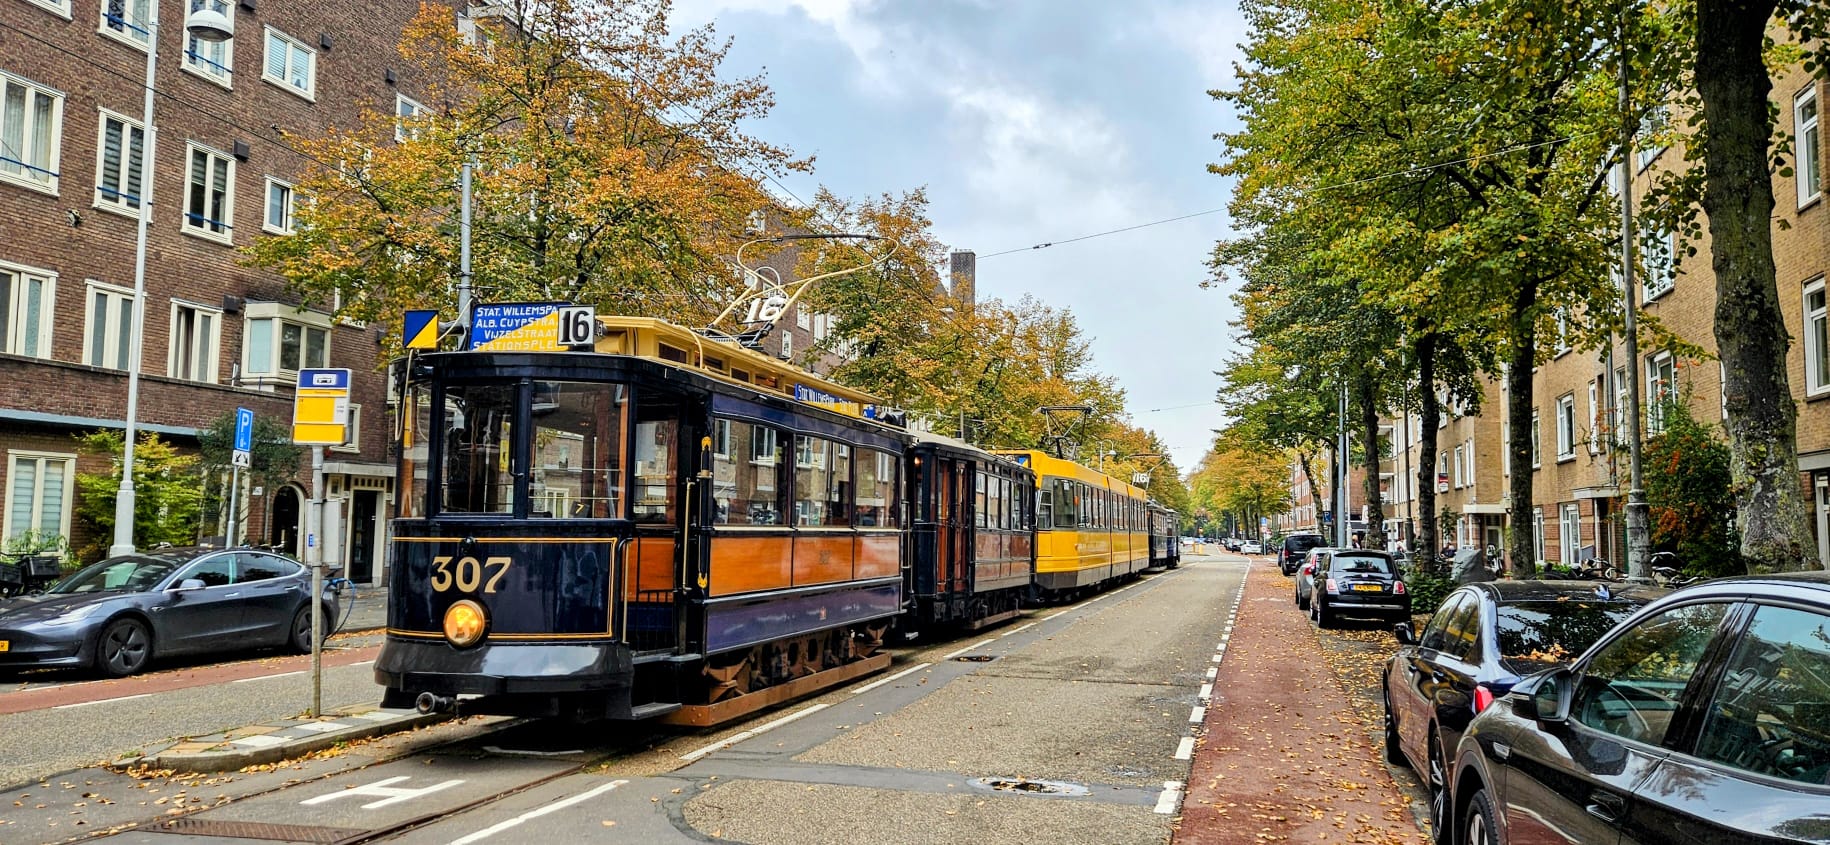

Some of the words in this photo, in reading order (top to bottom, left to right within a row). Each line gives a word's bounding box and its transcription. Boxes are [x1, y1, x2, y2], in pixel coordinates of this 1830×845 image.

[476, 307, 501, 317] STAT.
[743, 295, 787, 322] 16
[475, 318, 498, 328] ALB.
[500, 317, 558, 328] CUYPSTRA
[560, 310, 591, 343] 16
[241, 412, 250, 432] P
[576, 503, 585, 514] 7
[430, 556, 512, 593] 307
